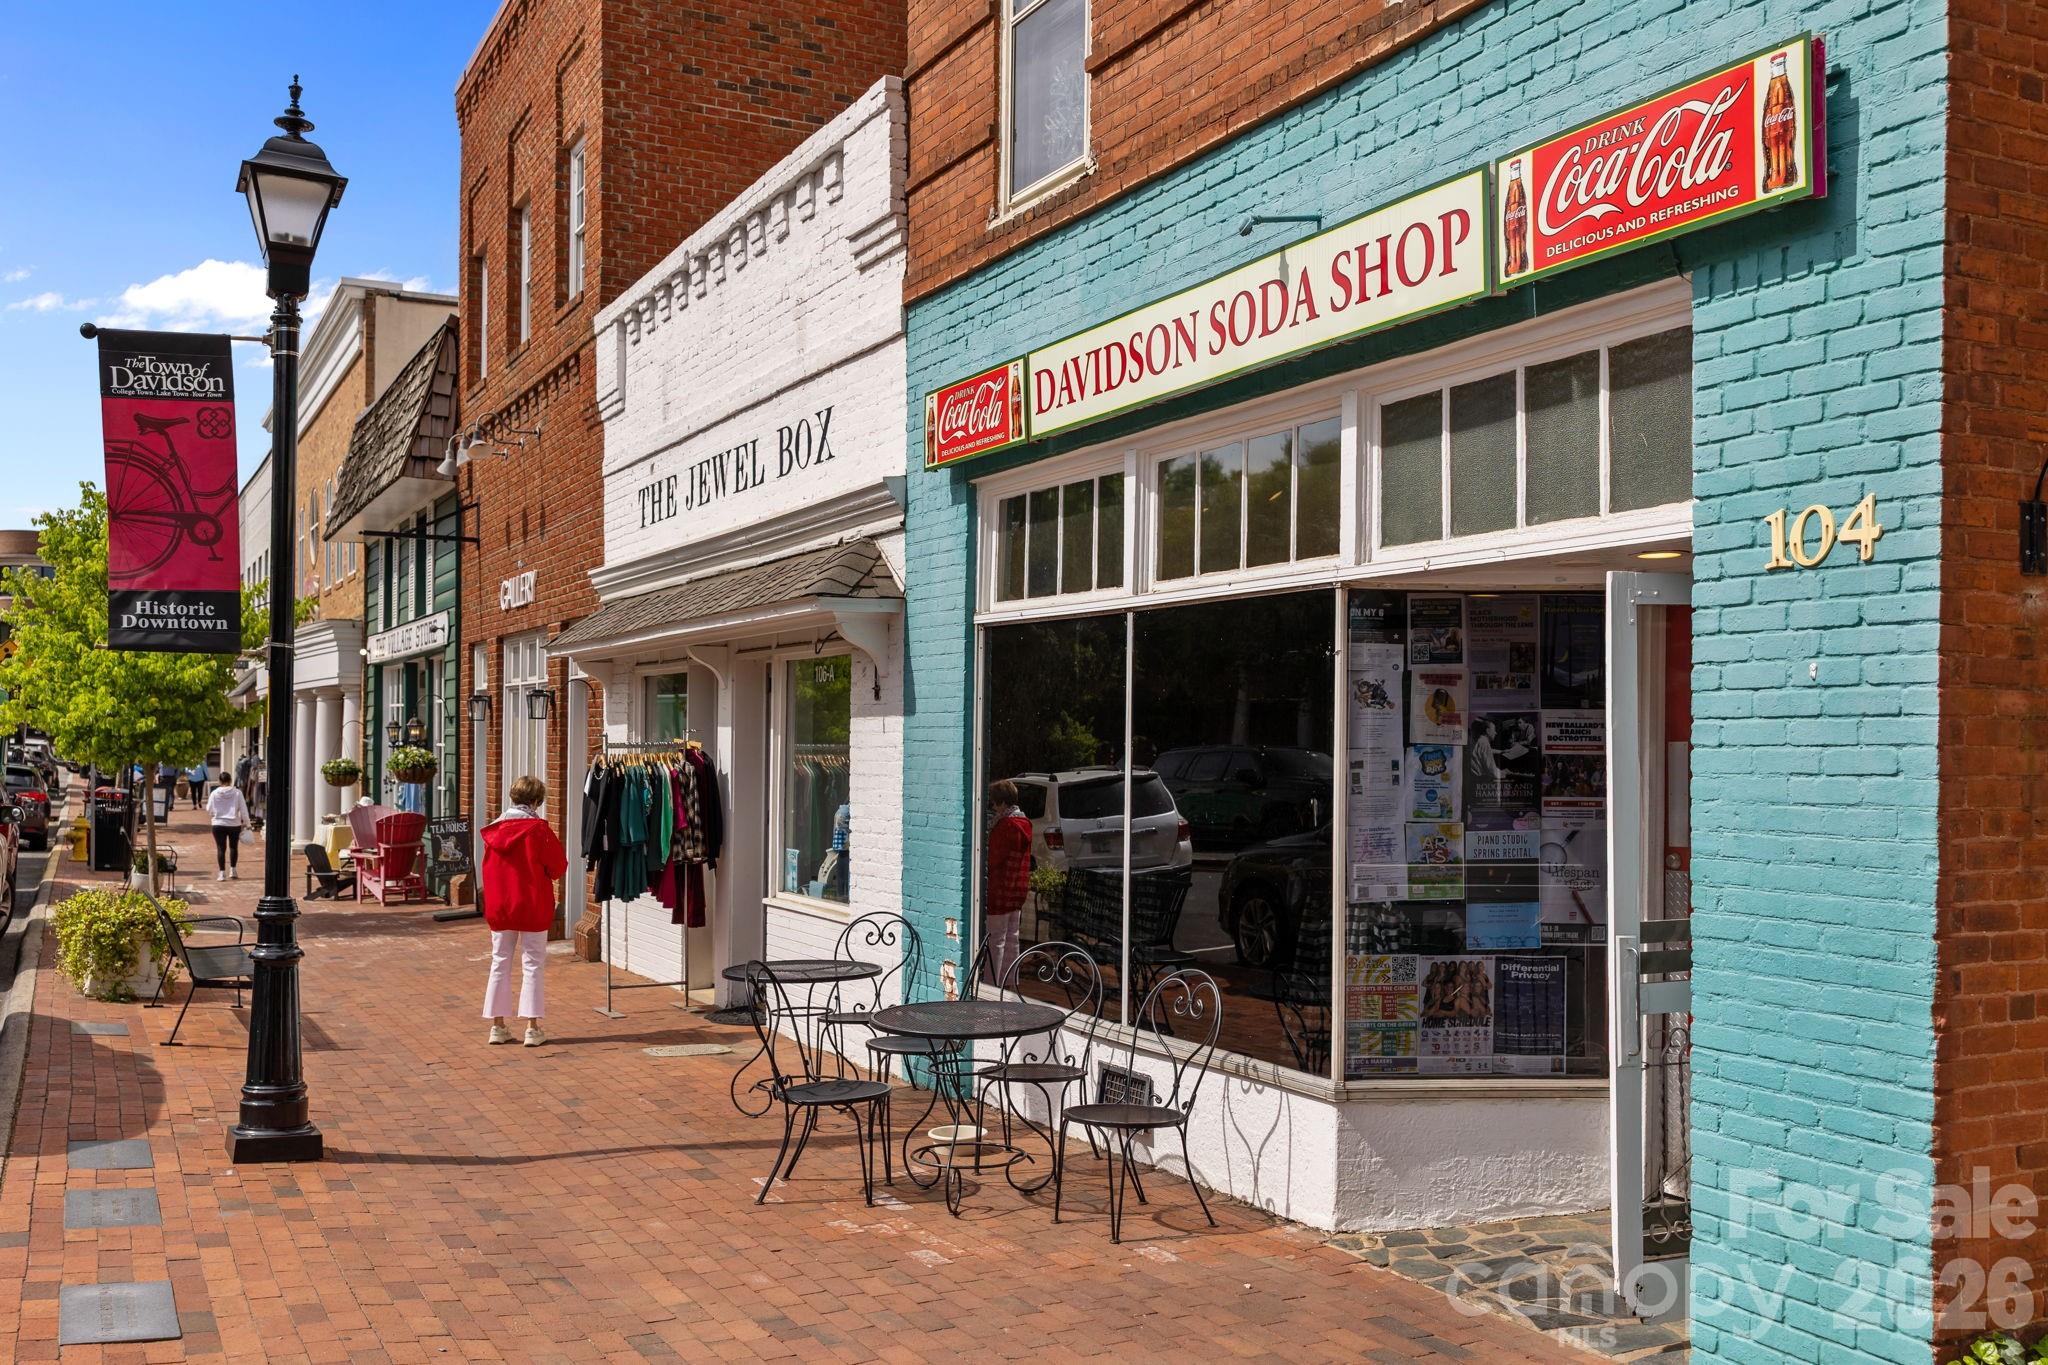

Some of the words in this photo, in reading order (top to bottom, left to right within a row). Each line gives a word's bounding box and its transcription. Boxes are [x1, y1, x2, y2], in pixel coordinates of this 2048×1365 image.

[1584, 116, 1647, 154] DRINK
[1537, 79, 1748, 236] Coca-Cola
[1546, 229, 1614, 257] DELICIOUS
[1616, 216, 1646, 235] AND
[1650, 185, 1739, 224] REFRESHING
[1035, 310, 1199, 416] DAVIDSON
[1208, 265, 1320, 356] SODA
[1330, 208, 1471, 313] SHOP
[109, 366, 226, 392] Davidson
[125, 358, 145, 368] The
[138, 355, 193, 374] Town
[190, 363, 210, 381] of
[112, 388, 135, 396] College
[955, 385, 975, 400] DRINK
[939, 376, 1007, 444] Coca-Cola
[942, 445, 965, 457] DELICIOUS
[975, 432, 1005, 446] REFRESHING
[638, 475, 677, 528] THE
[685, 439, 765, 511] JEWEL
[776, 405, 835, 478] BOX
[1763, 492, 1883, 571] 104
[500, 570, 537, 610] GALLERY
[135, 600, 215, 616] Historic
[121, 614, 228, 630] Downtown
[376, 637, 386, 658] THE
[388, 628, 412, 654] VILLAGE
[815, 664, 835, 682] 106-A
[430, 825, 445, 834] TEA
[445, 822, 468, 833] HOUSE
[1477, 835, 1499, 845] PIANO
[1473, 848, 1500, 858] SPRING
[1503, 847, 1532, 857] RECITAL
[1500, 963, 1560, 972] Differential
[1511, 971, 1551, 980] Privacy
[1421, 1016, 1446, 1029] HOME
[1448, 1015, 1491, 1028] SCHEDULE
